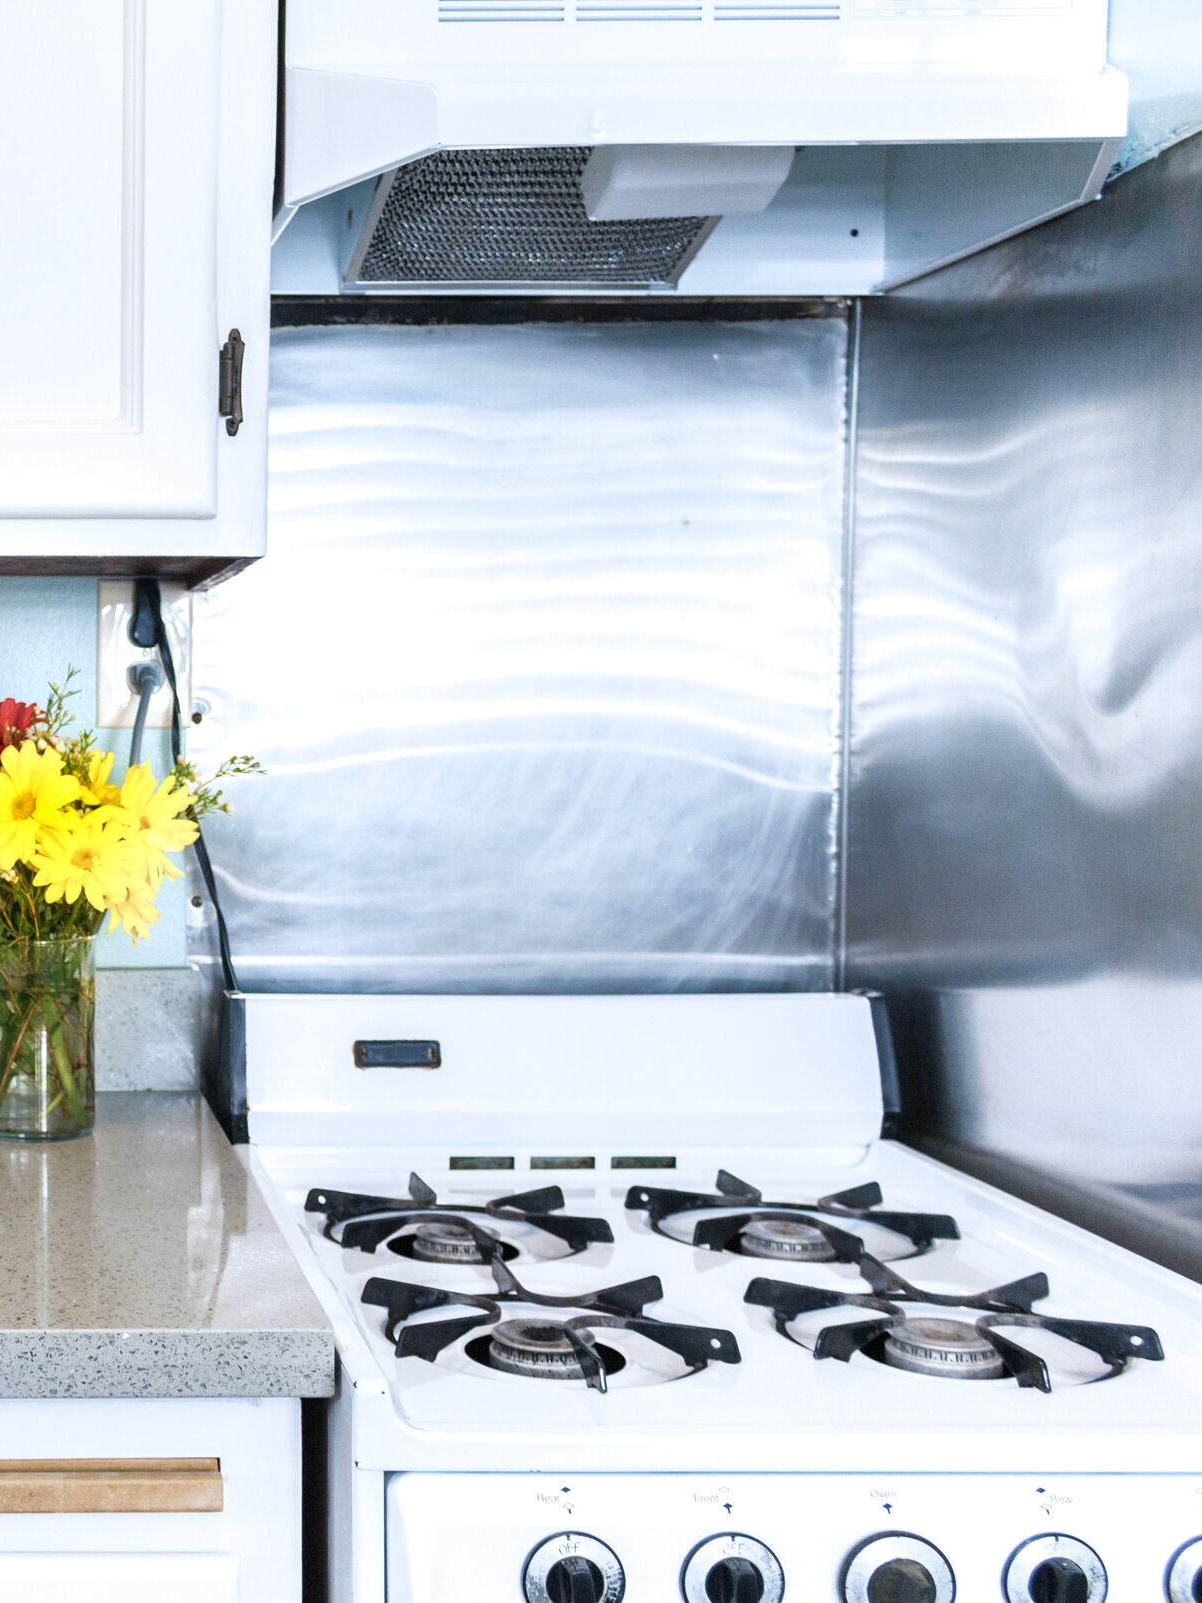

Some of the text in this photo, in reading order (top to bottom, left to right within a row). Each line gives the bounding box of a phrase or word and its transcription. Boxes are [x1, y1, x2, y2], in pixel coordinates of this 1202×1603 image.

[536, 1493, 560, 1503] Rear
[693, 1493, 719, 1503] Front
[869, 1489, 898, 1499] Oven
[558, 1541, 581, 1556] OFF
